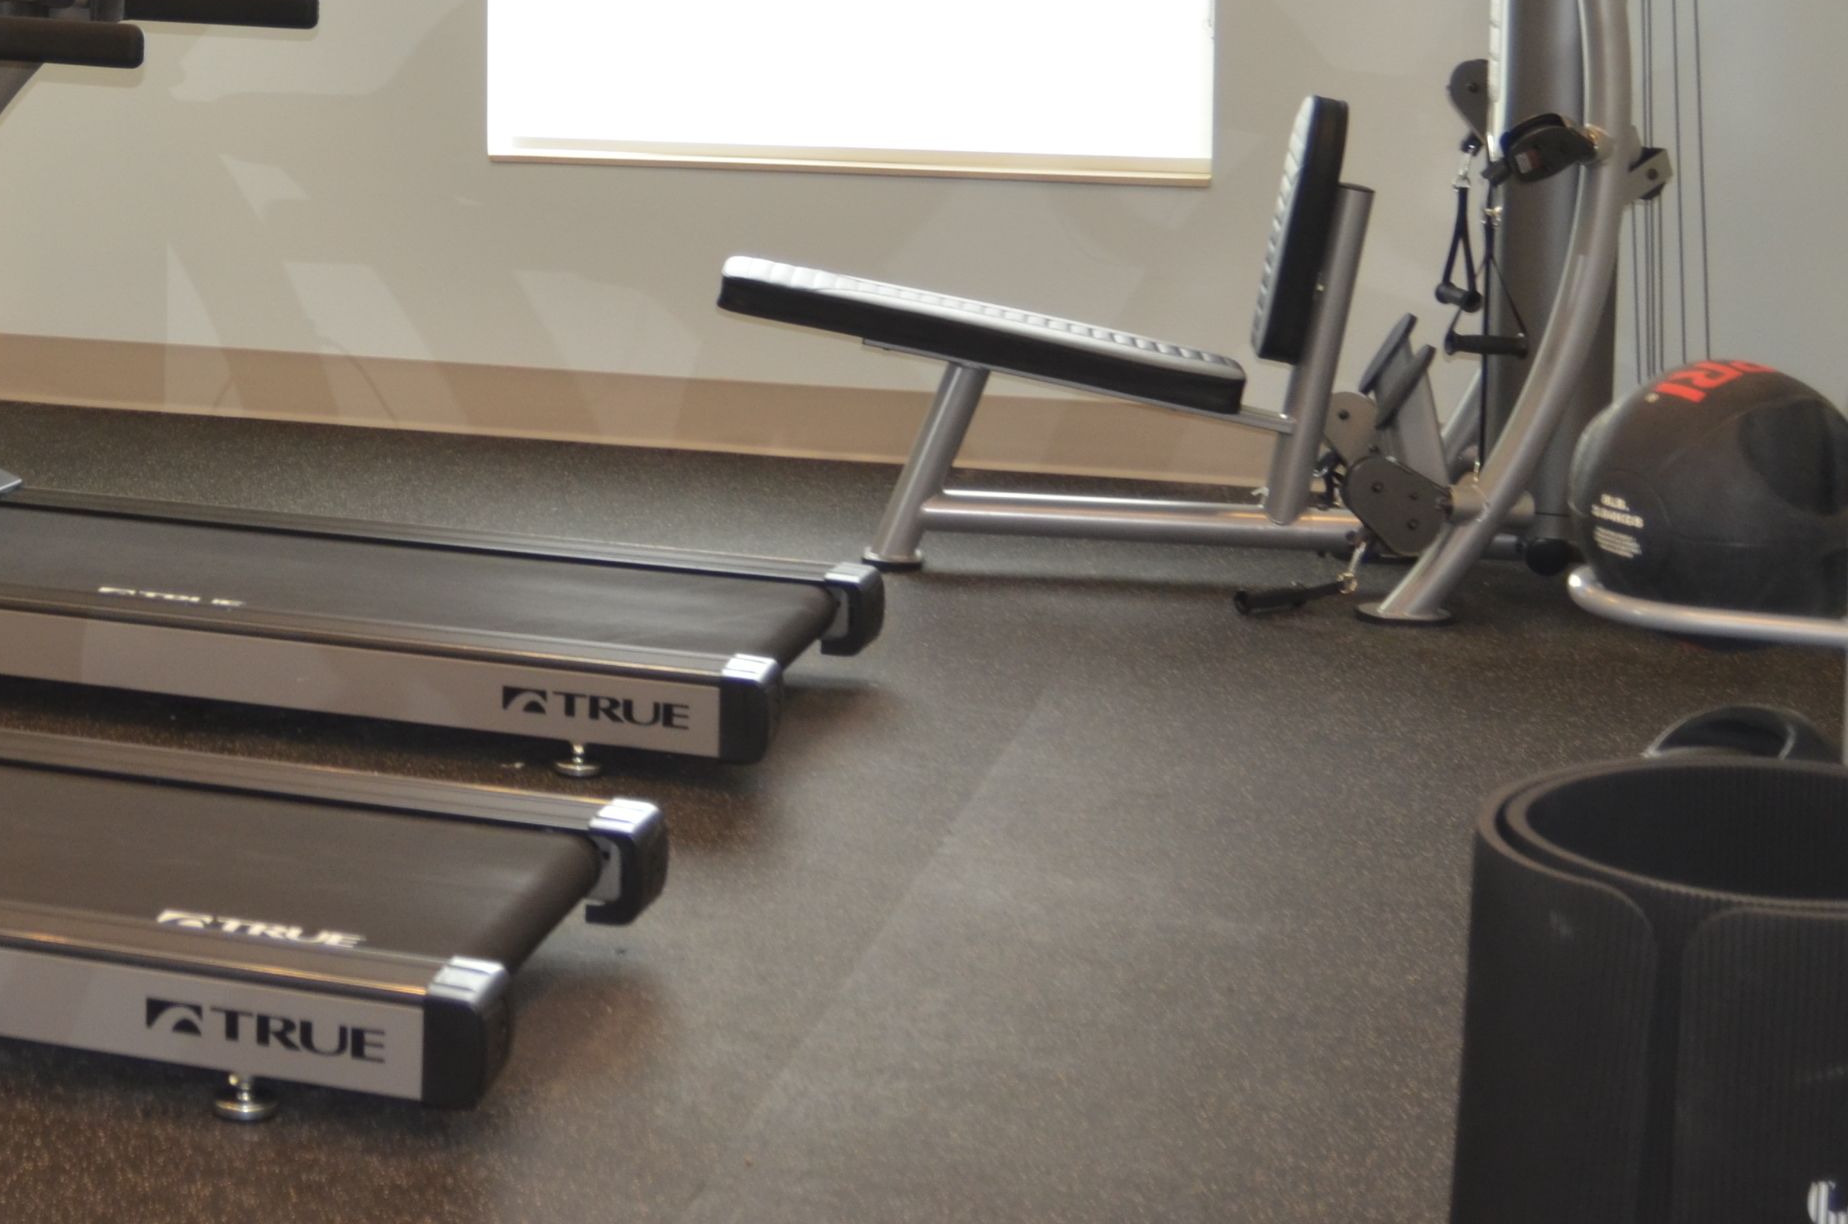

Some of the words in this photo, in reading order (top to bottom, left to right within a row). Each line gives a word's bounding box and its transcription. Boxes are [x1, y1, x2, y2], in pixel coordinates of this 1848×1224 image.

[553, 690, 691, 731] TRUE
[214, 917, 367, 949] TRUE
[209, 1004, 386, 1065] TRUE
